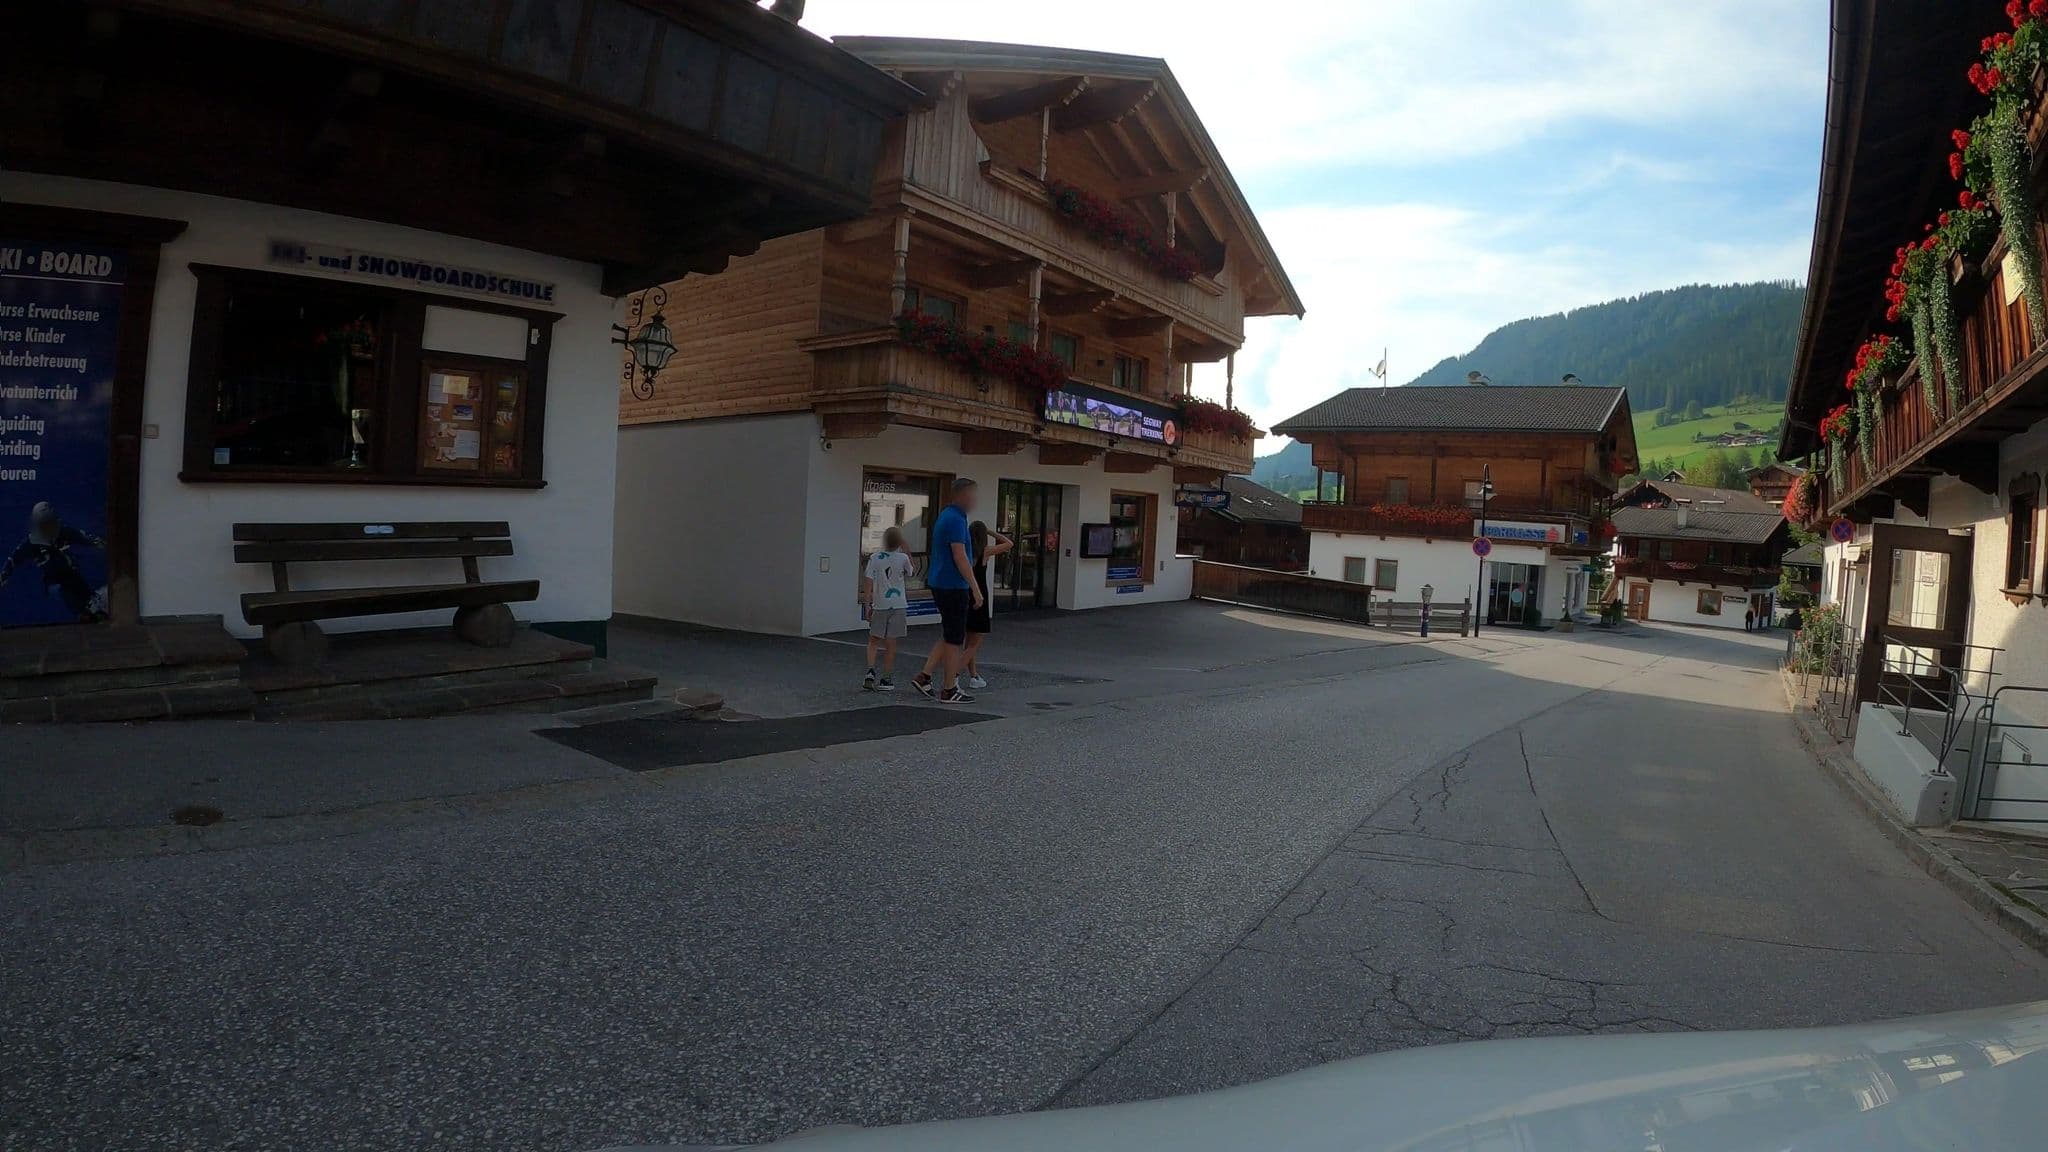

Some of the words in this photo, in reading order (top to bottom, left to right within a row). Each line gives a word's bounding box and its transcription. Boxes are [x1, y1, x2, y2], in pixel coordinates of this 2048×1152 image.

[0, 248, 22, 271] KI
[40, 251, 112, 276] BOARD
[318, 255, 352, 270] und
[358, 255, 555, 302] SNOWBOARDSCHULE
[0, 303, 25, 318] urse
[28, 303, 100, 321] Erwachsene
[25, 327, 66, 343] Kinder
[0, 415, 45, 435] guiding
